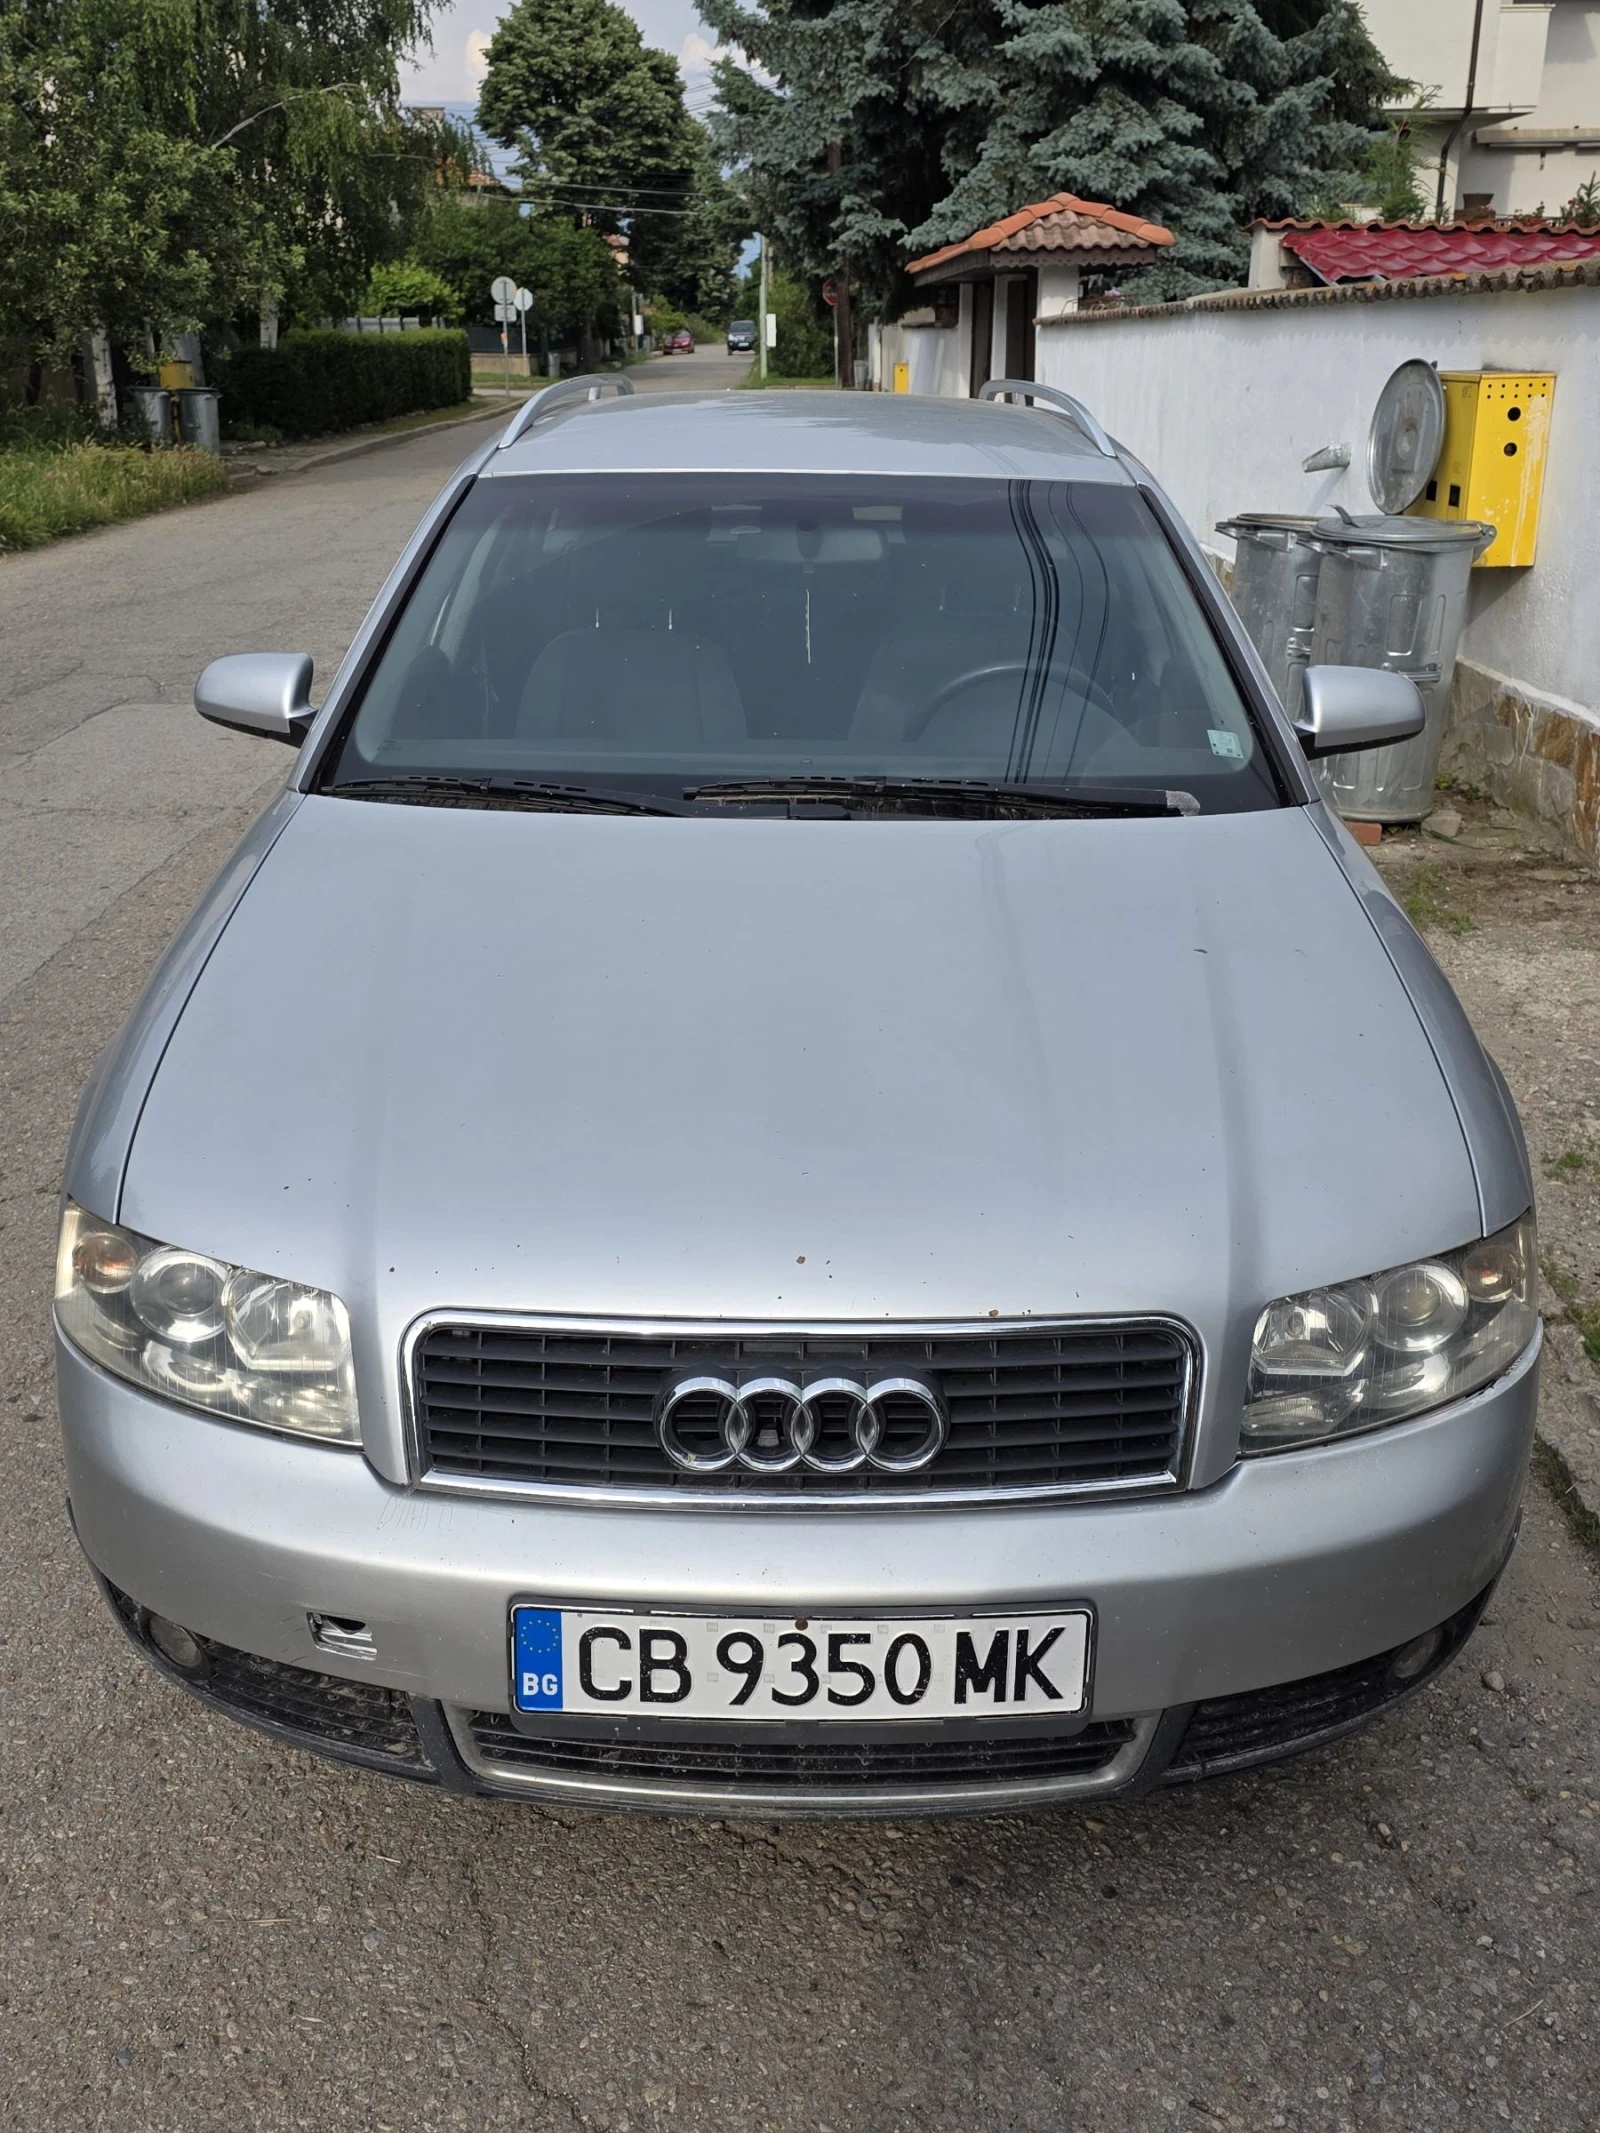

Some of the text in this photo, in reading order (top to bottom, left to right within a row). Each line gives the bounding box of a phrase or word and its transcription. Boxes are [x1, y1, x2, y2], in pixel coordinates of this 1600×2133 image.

[522, 1672, 558, 1696] BG
[579, 1626, 1066, 1706] CB 9350 MK
